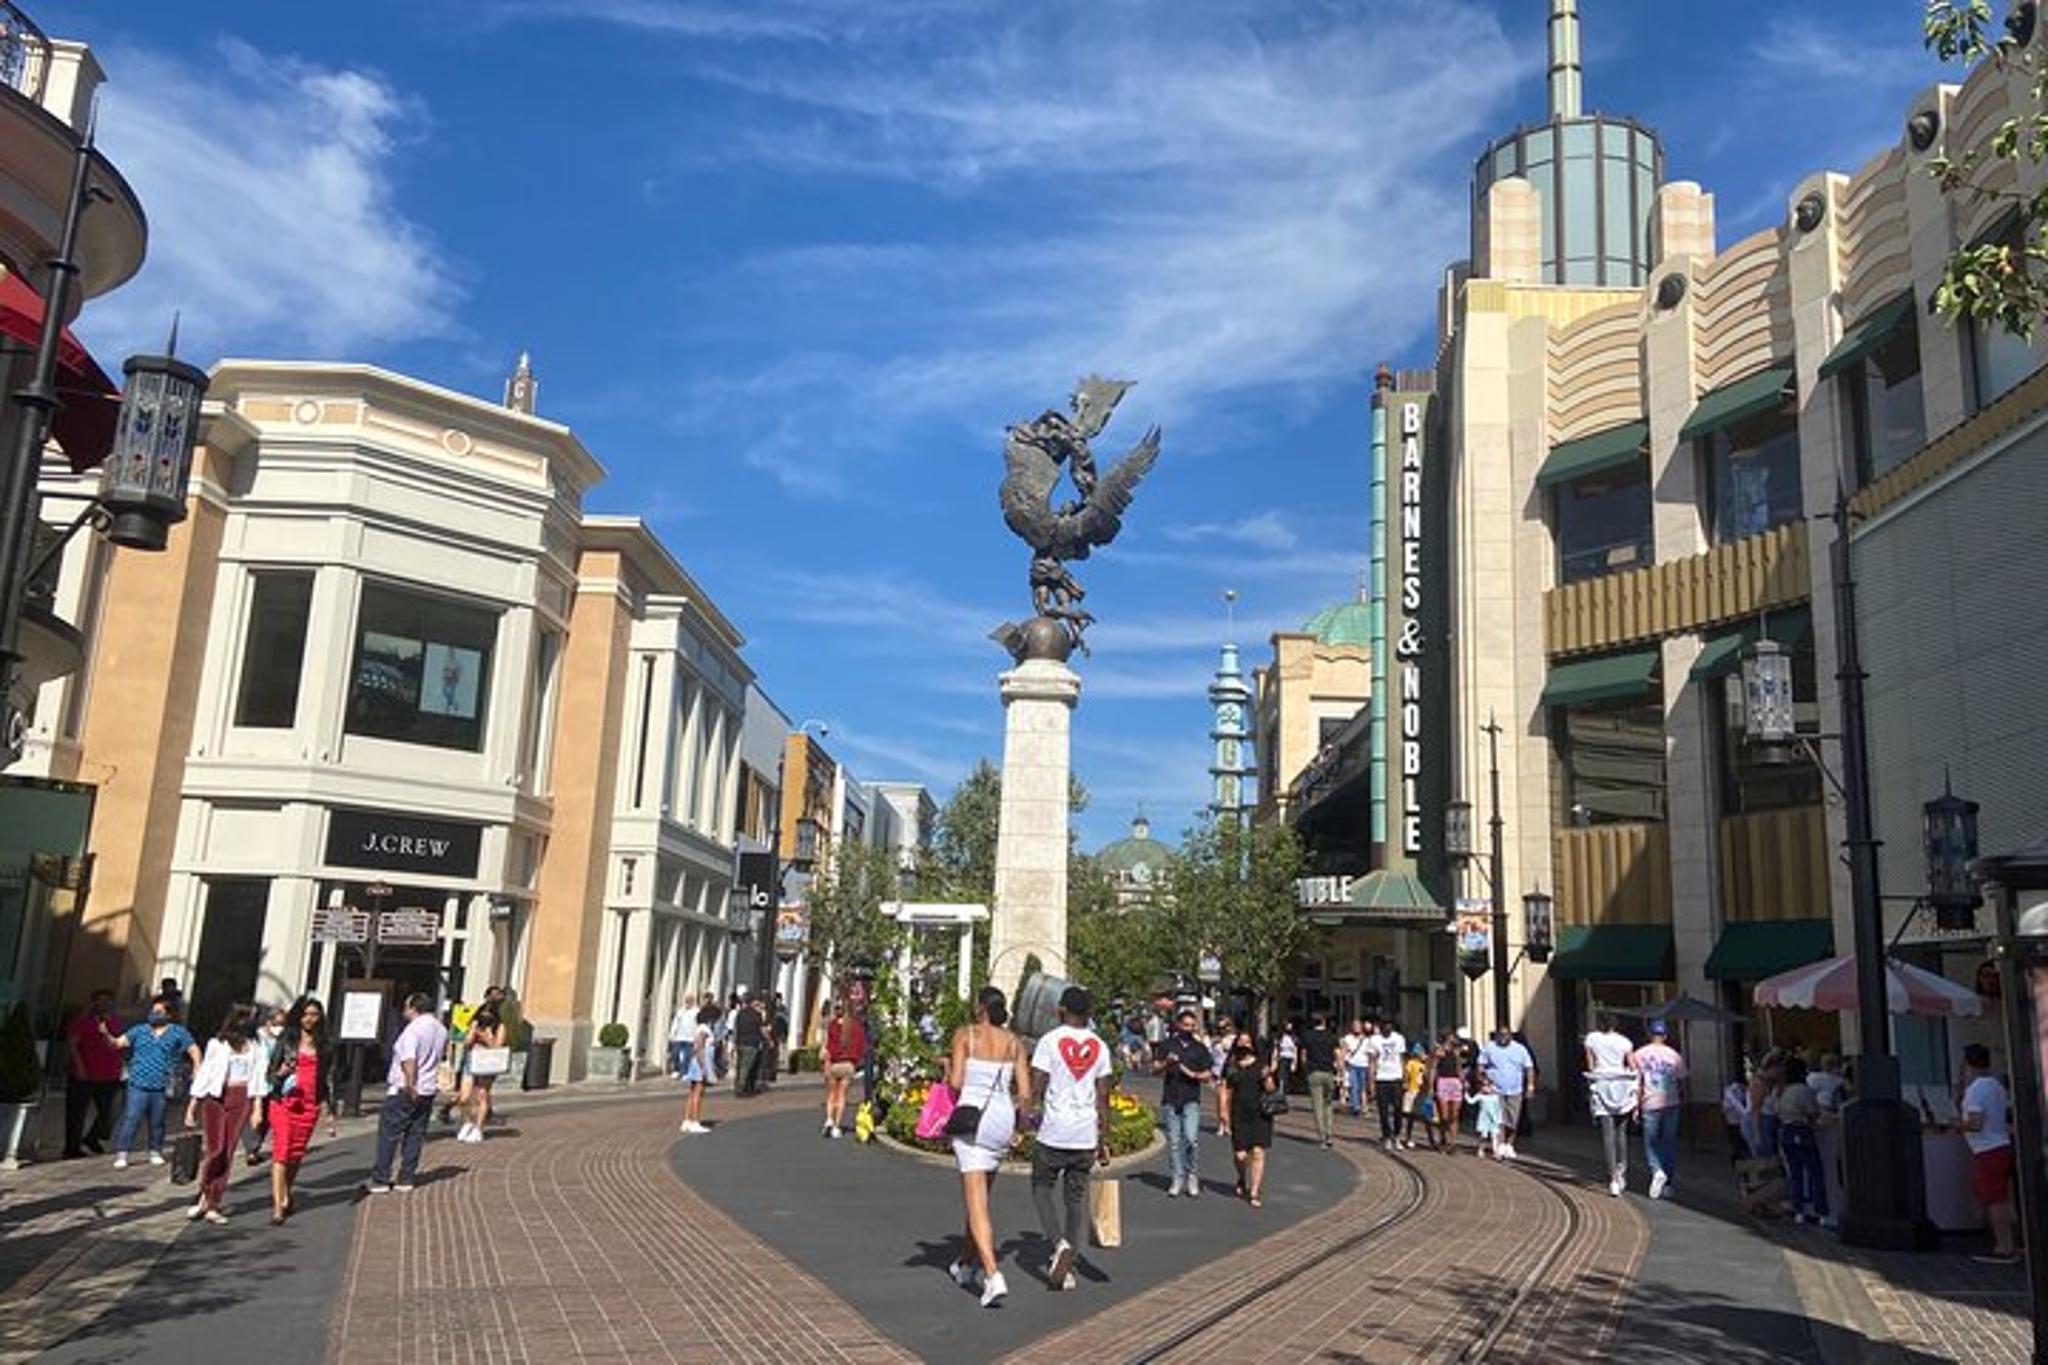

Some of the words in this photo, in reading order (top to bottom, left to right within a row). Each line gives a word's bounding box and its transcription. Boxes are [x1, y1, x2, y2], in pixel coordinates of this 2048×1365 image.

[1404, 403, 1420, 609] BARNES
[1398, 619, 1425, 654] &
[1404, 667, 1420, 850] NOBLE
[362, 832, 450, 857] J.CREW
